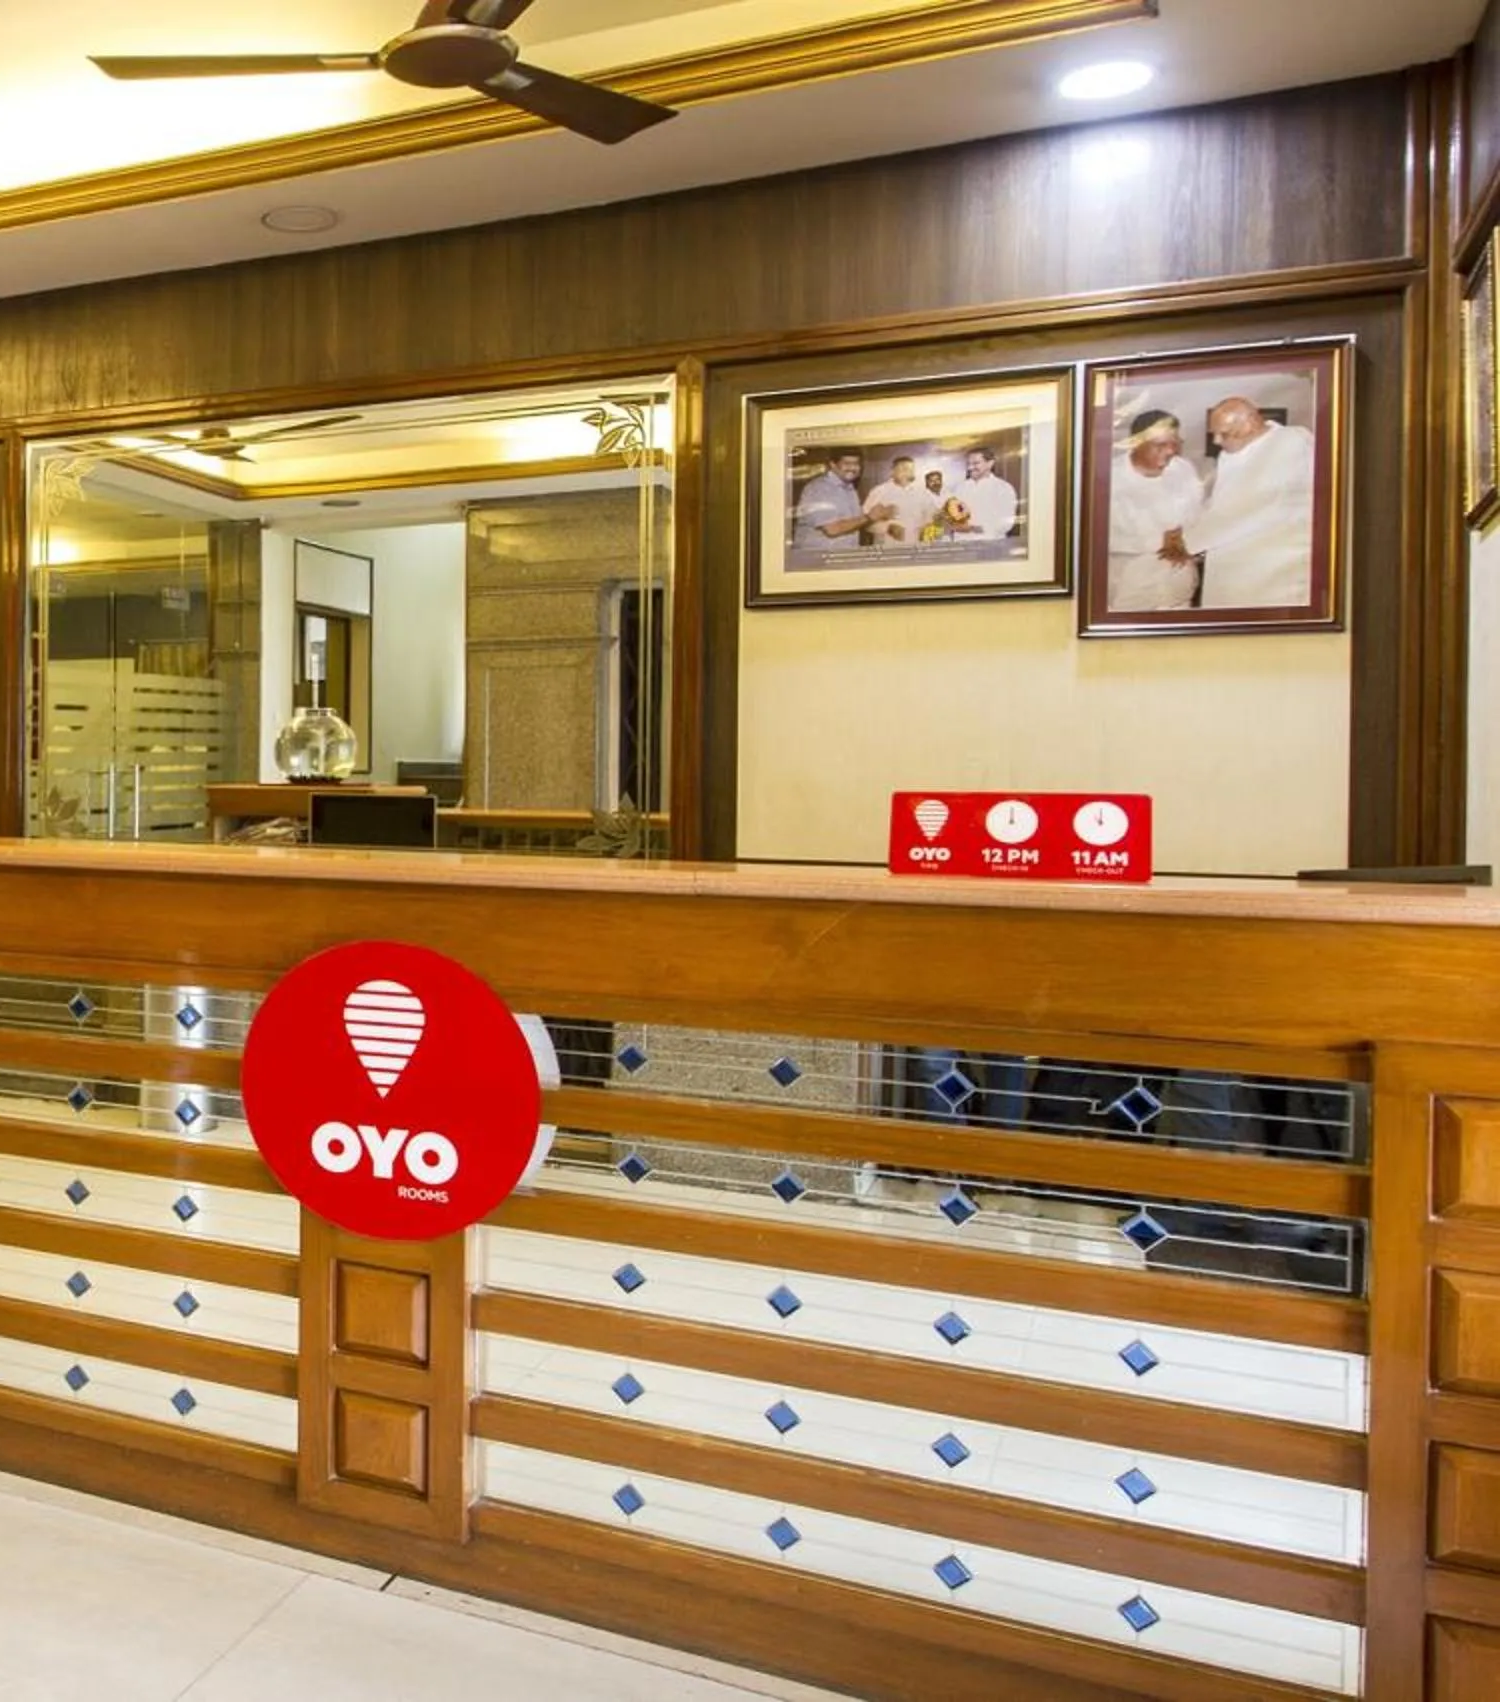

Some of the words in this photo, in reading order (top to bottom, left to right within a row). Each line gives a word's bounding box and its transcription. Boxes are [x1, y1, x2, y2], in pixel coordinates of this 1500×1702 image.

[909, 847, 952, 861] OYO
[981, 848, 1003, 863] 12
[1007, 848, 1040, 865] PM
[1070, 849, 1091, 865] 11
[1093, 850, 1129, 867] AM
[311, 1121, 459, 1185] OYO
[397, 1185, 449, 1204] ROOMS
